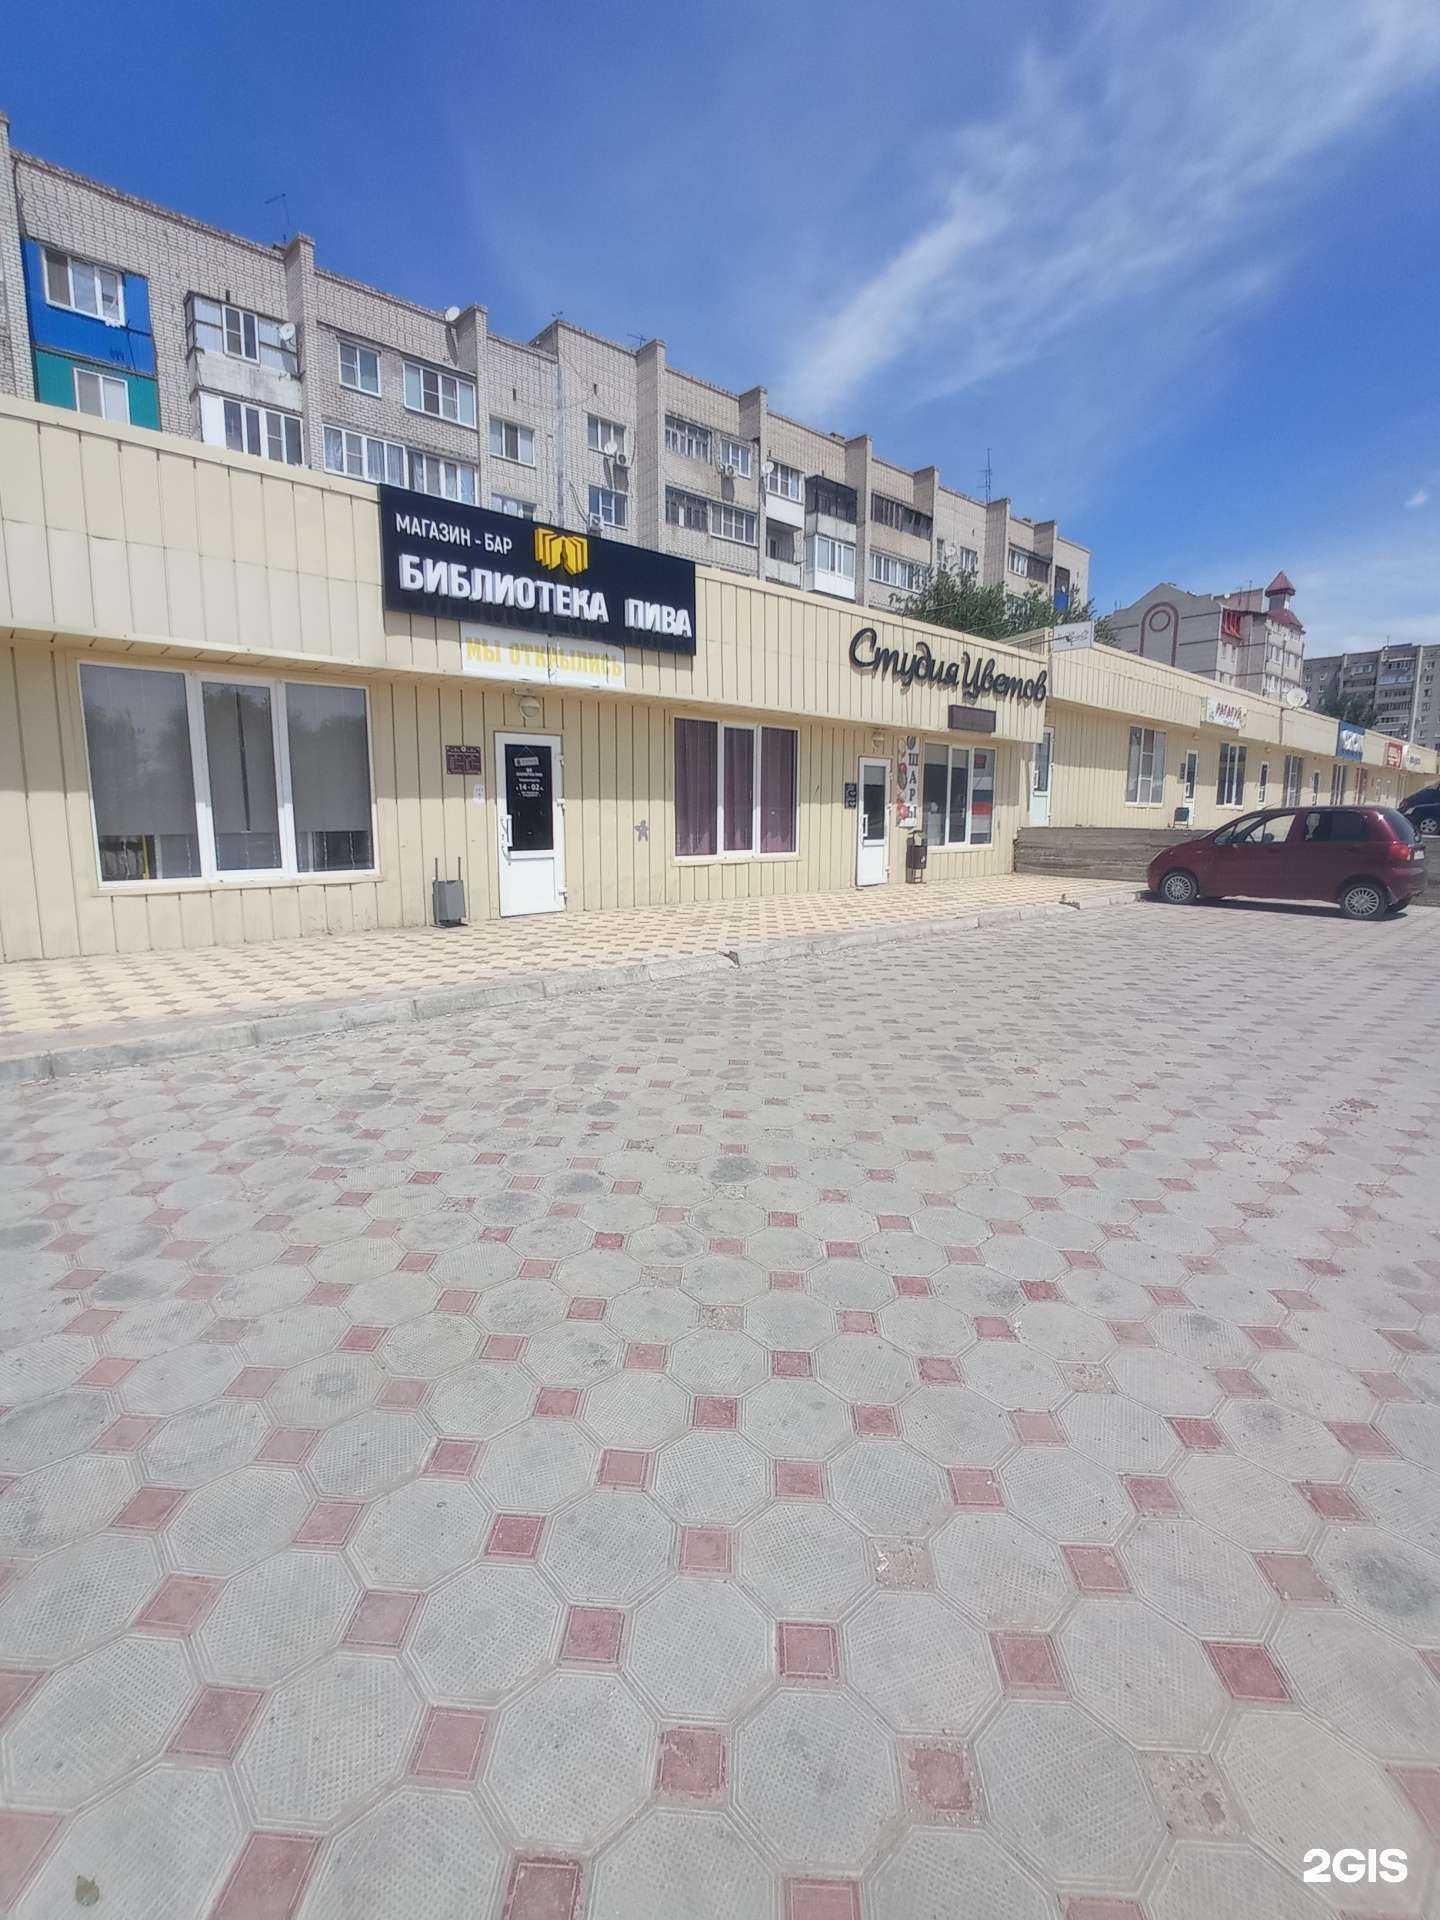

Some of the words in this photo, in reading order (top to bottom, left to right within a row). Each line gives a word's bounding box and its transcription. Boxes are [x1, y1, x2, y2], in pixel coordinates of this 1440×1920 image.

[394, 512, 471, 547] МАГАЗИН
[484, 532, 513, 556] БАР
[398, 553, 609, 623] БИБЛИОТЕКА
[624, 597, 692, 639] ПИВА
[465, 636, 501, 664] МЫ
[848, 627, 960, 688] Студия
[962, 652, 1048, 701] Цветов
